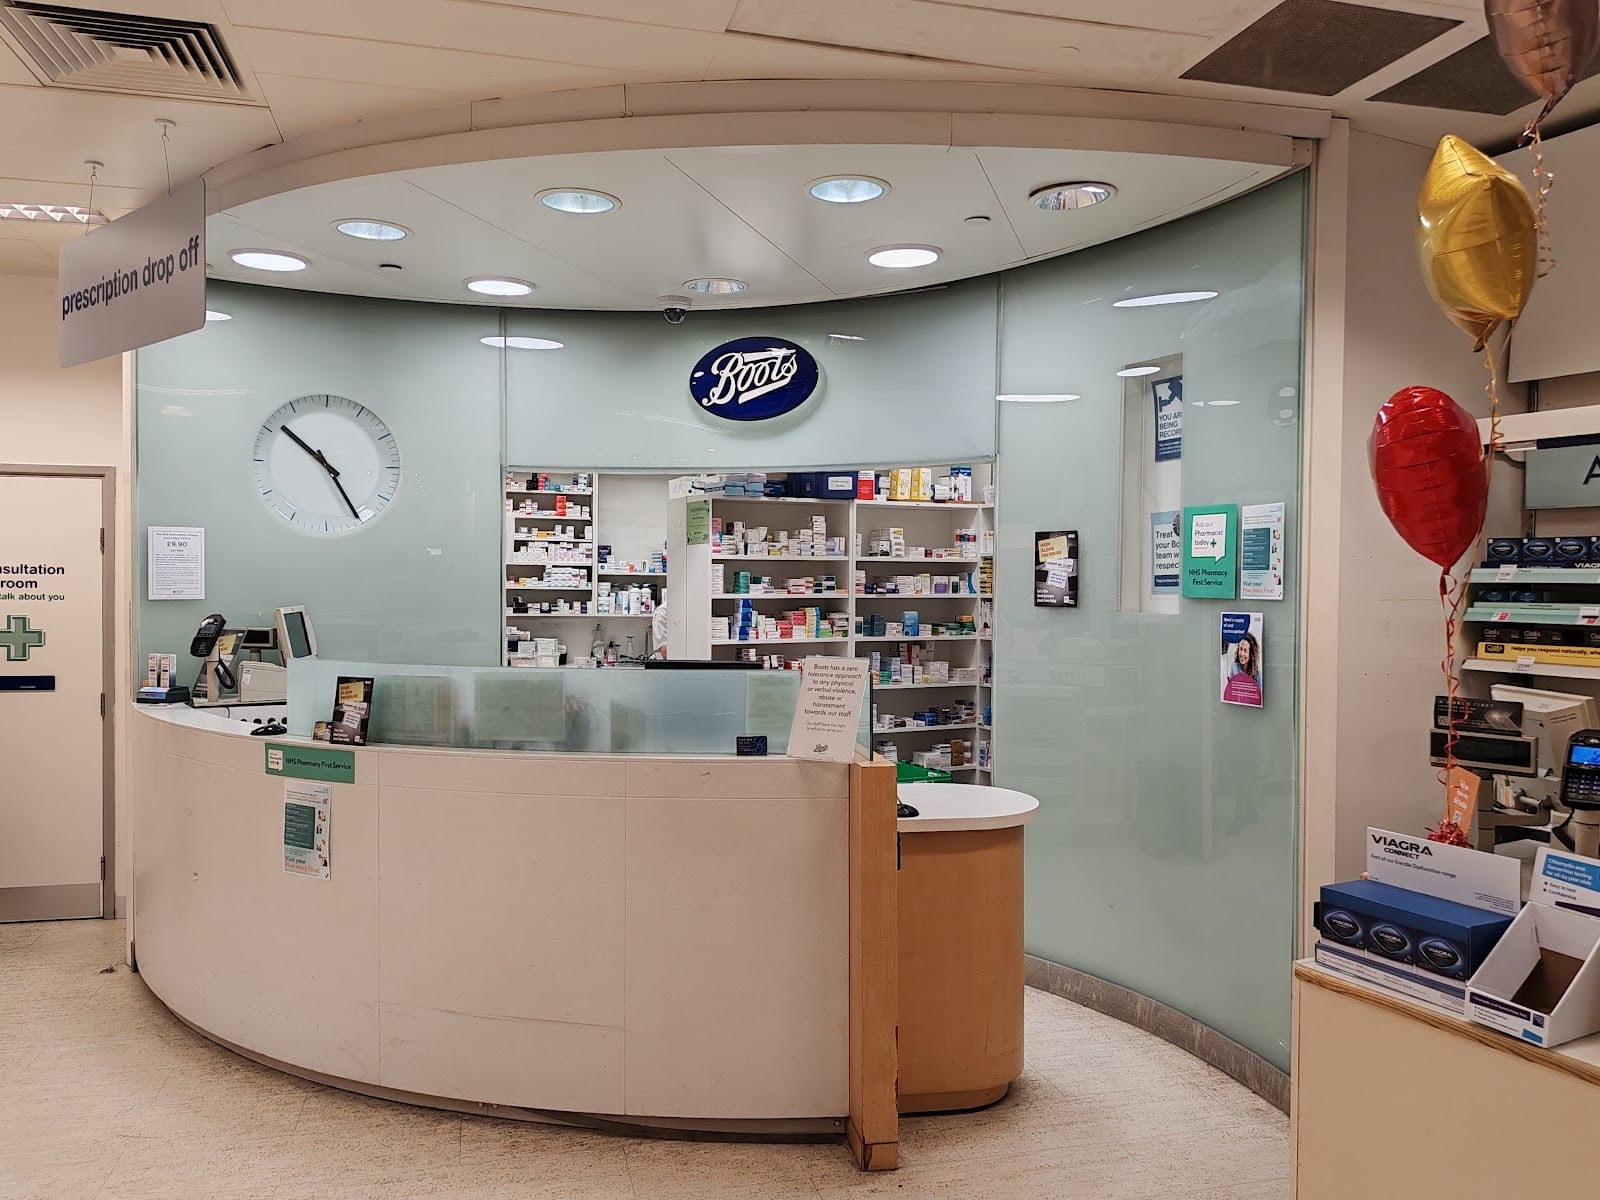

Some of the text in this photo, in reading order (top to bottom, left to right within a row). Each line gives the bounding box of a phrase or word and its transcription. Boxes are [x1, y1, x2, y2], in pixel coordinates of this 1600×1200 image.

[62, 234, 200, 321] prescription drop off
[702, 347, 798, 407] Boots
[1159, 413, 1172, 422] YOU
[1160, 420, 1178, 430] BEING
[1156, 531, 1174, 539] Treat
[1194, 529, 1224, 537] Pharmacist
[1156, 542, 1170, 550] your
[0, 564, 65, 575] sultation
[1201, 569, 1228, 578] Pharmacy
[0, 580, 38, 588] room
[813, 744, 828, 752] Boots
[297, 759, 320, 768] Pharmacy
[333, 762, 352, 770] Service
[1372, 834, 1433, 856] VIAGRA
[1384, 847, 1420, 860] CONNECT
[1395, 859, 1412, 867] Erectile
[1412, 864, 1440, 875] Dysfunction
